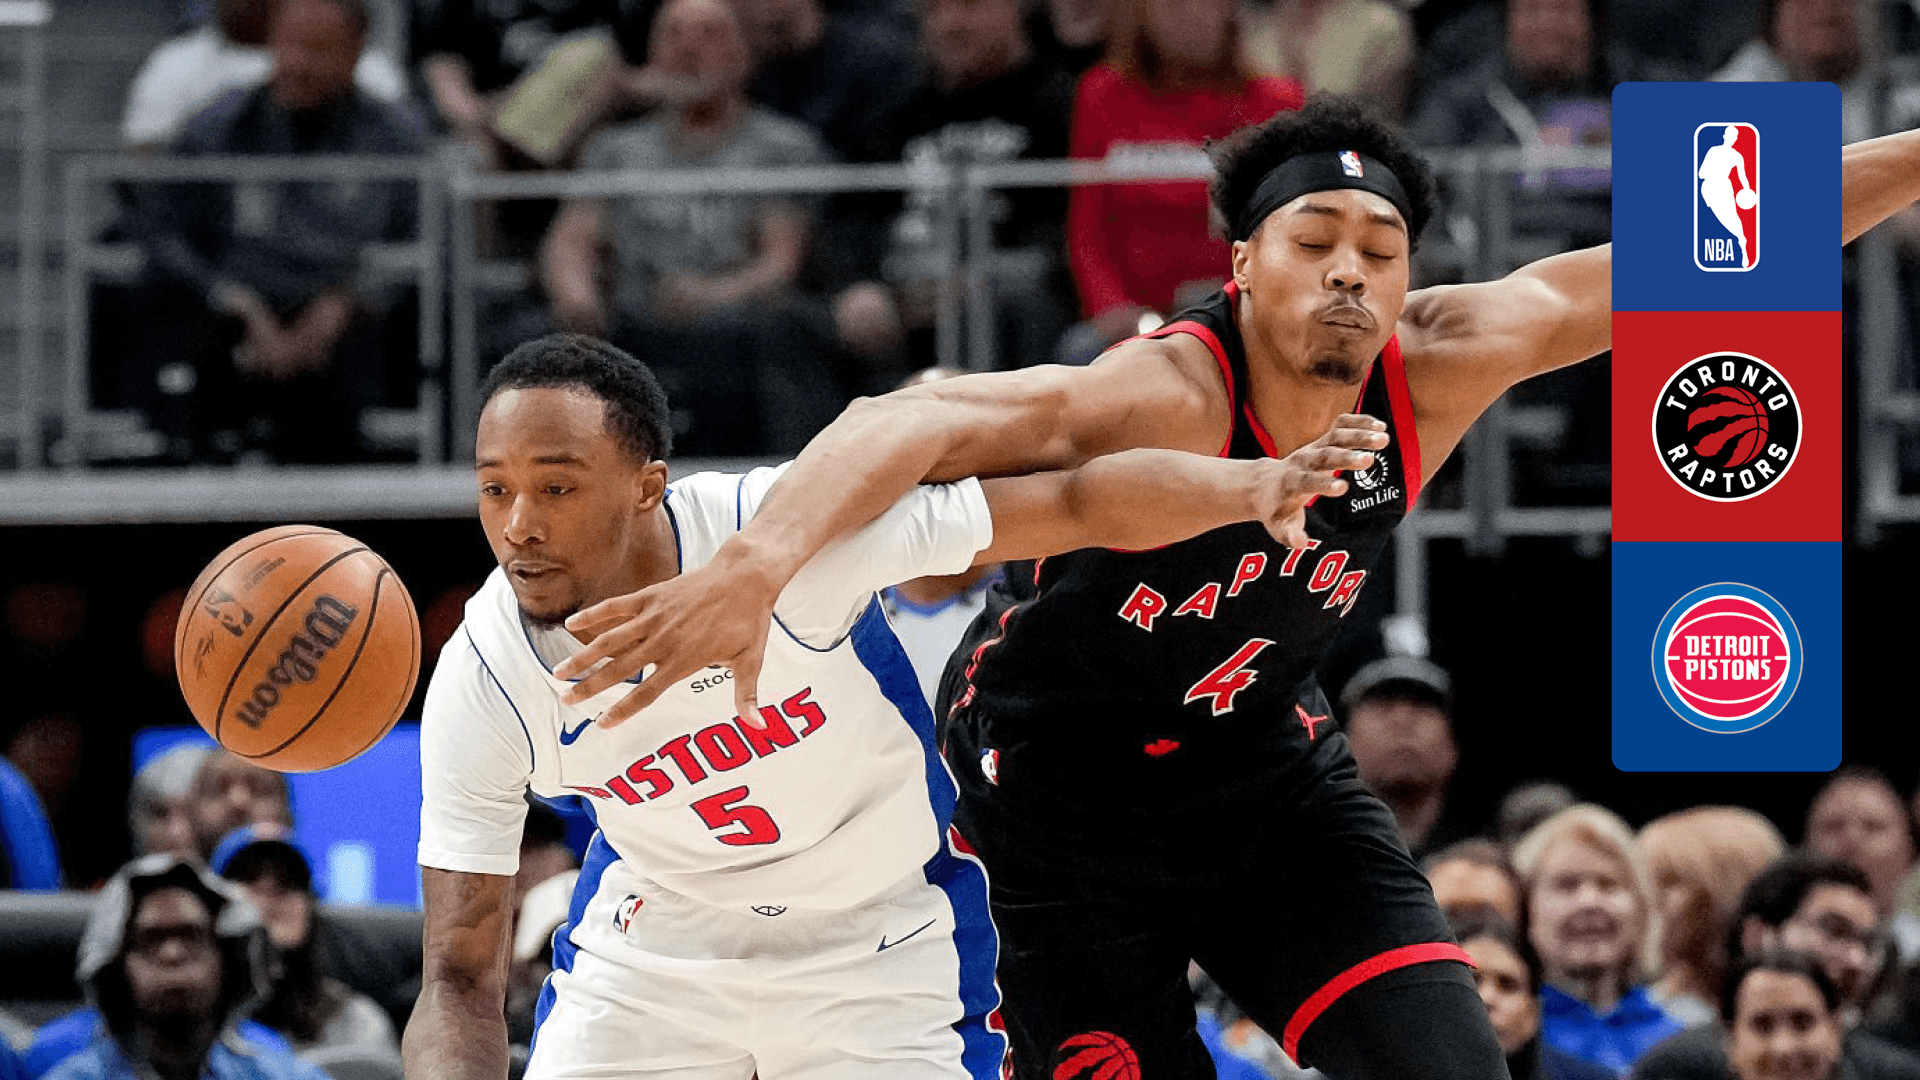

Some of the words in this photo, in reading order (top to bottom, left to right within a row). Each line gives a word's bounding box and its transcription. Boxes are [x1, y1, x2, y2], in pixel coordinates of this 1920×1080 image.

[1350, 498, 1375, 513] Sun
[1375, 486, 1400, 504] Life
[1117, 538, 1367, 632] RAPTOR
[235, 594, 359, 731] Wilson
[1184, 638, 1277, 716] 4
[690, 785, 781, 846] 5
